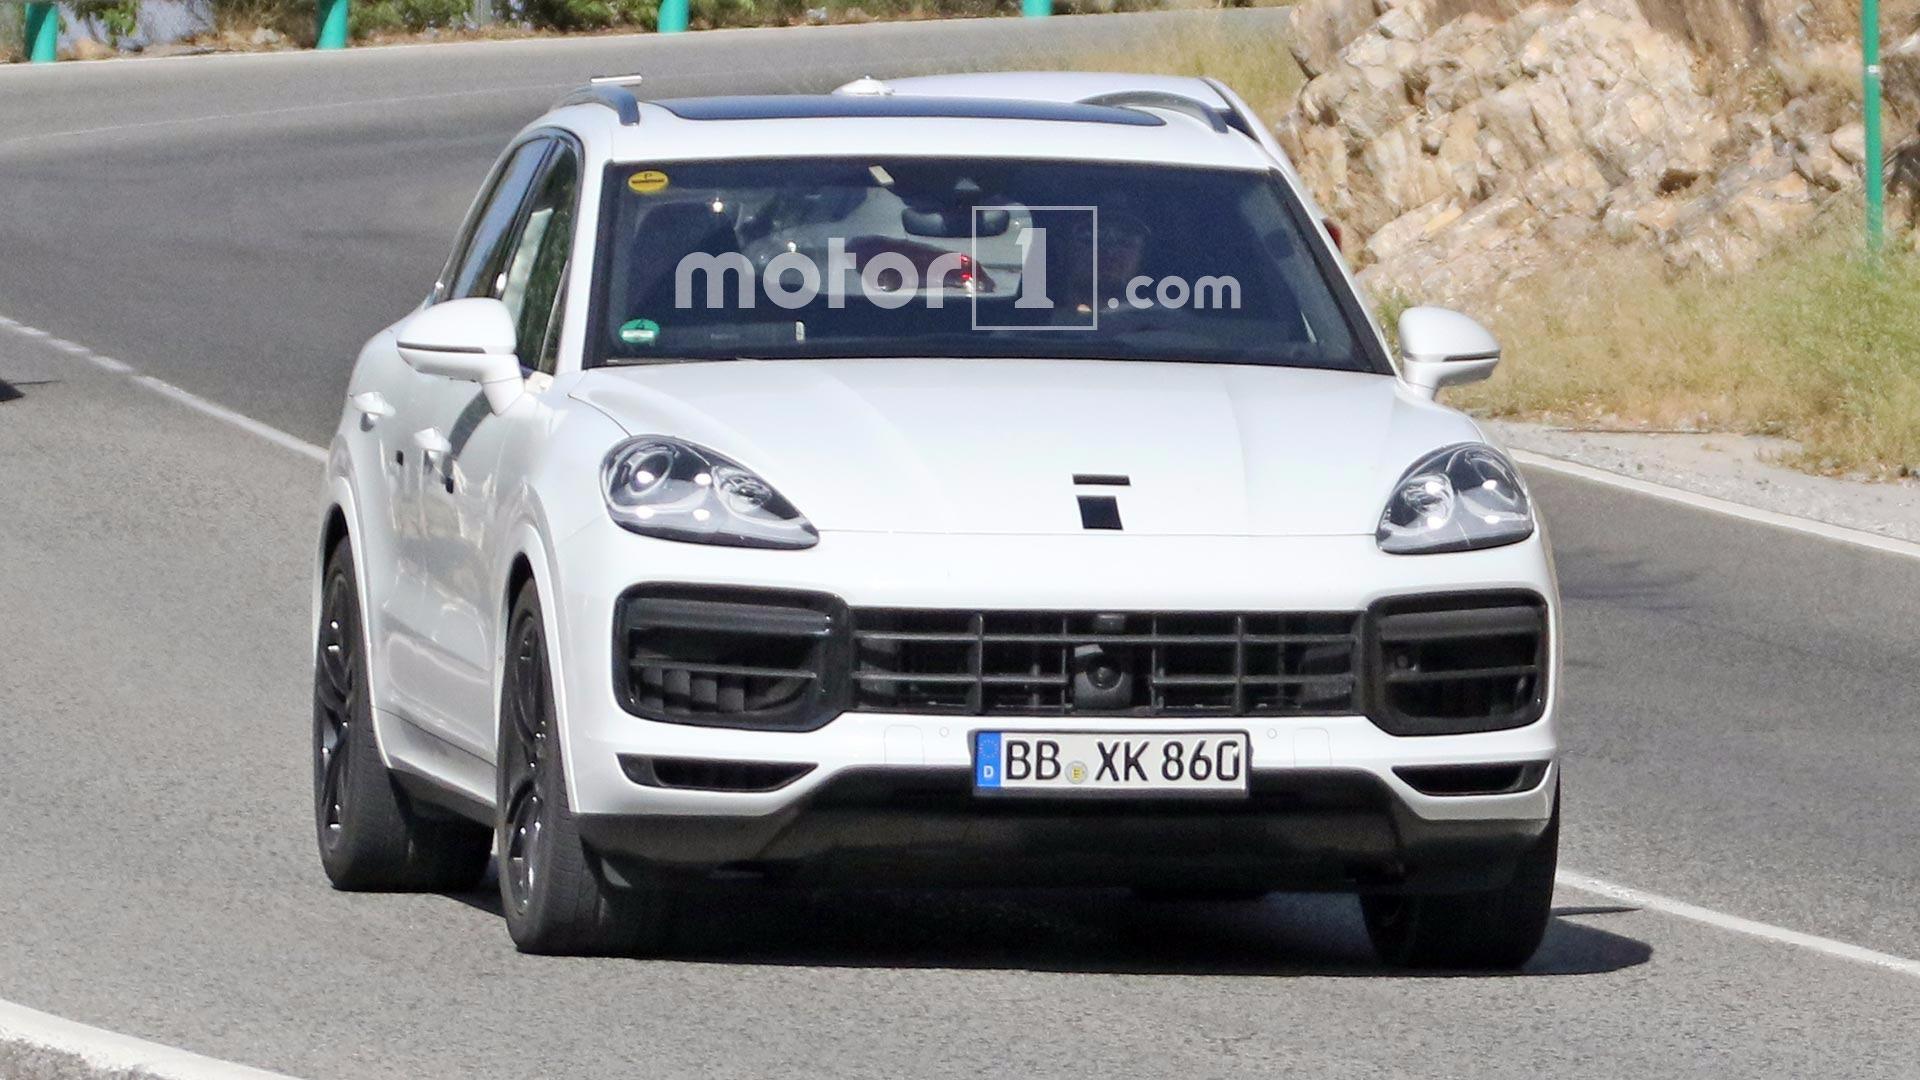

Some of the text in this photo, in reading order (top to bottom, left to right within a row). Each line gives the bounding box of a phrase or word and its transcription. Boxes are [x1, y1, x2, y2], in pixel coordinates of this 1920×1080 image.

[983, 765, 994, 778] D
[1005, 740, 1240, 781] BB XK 860
